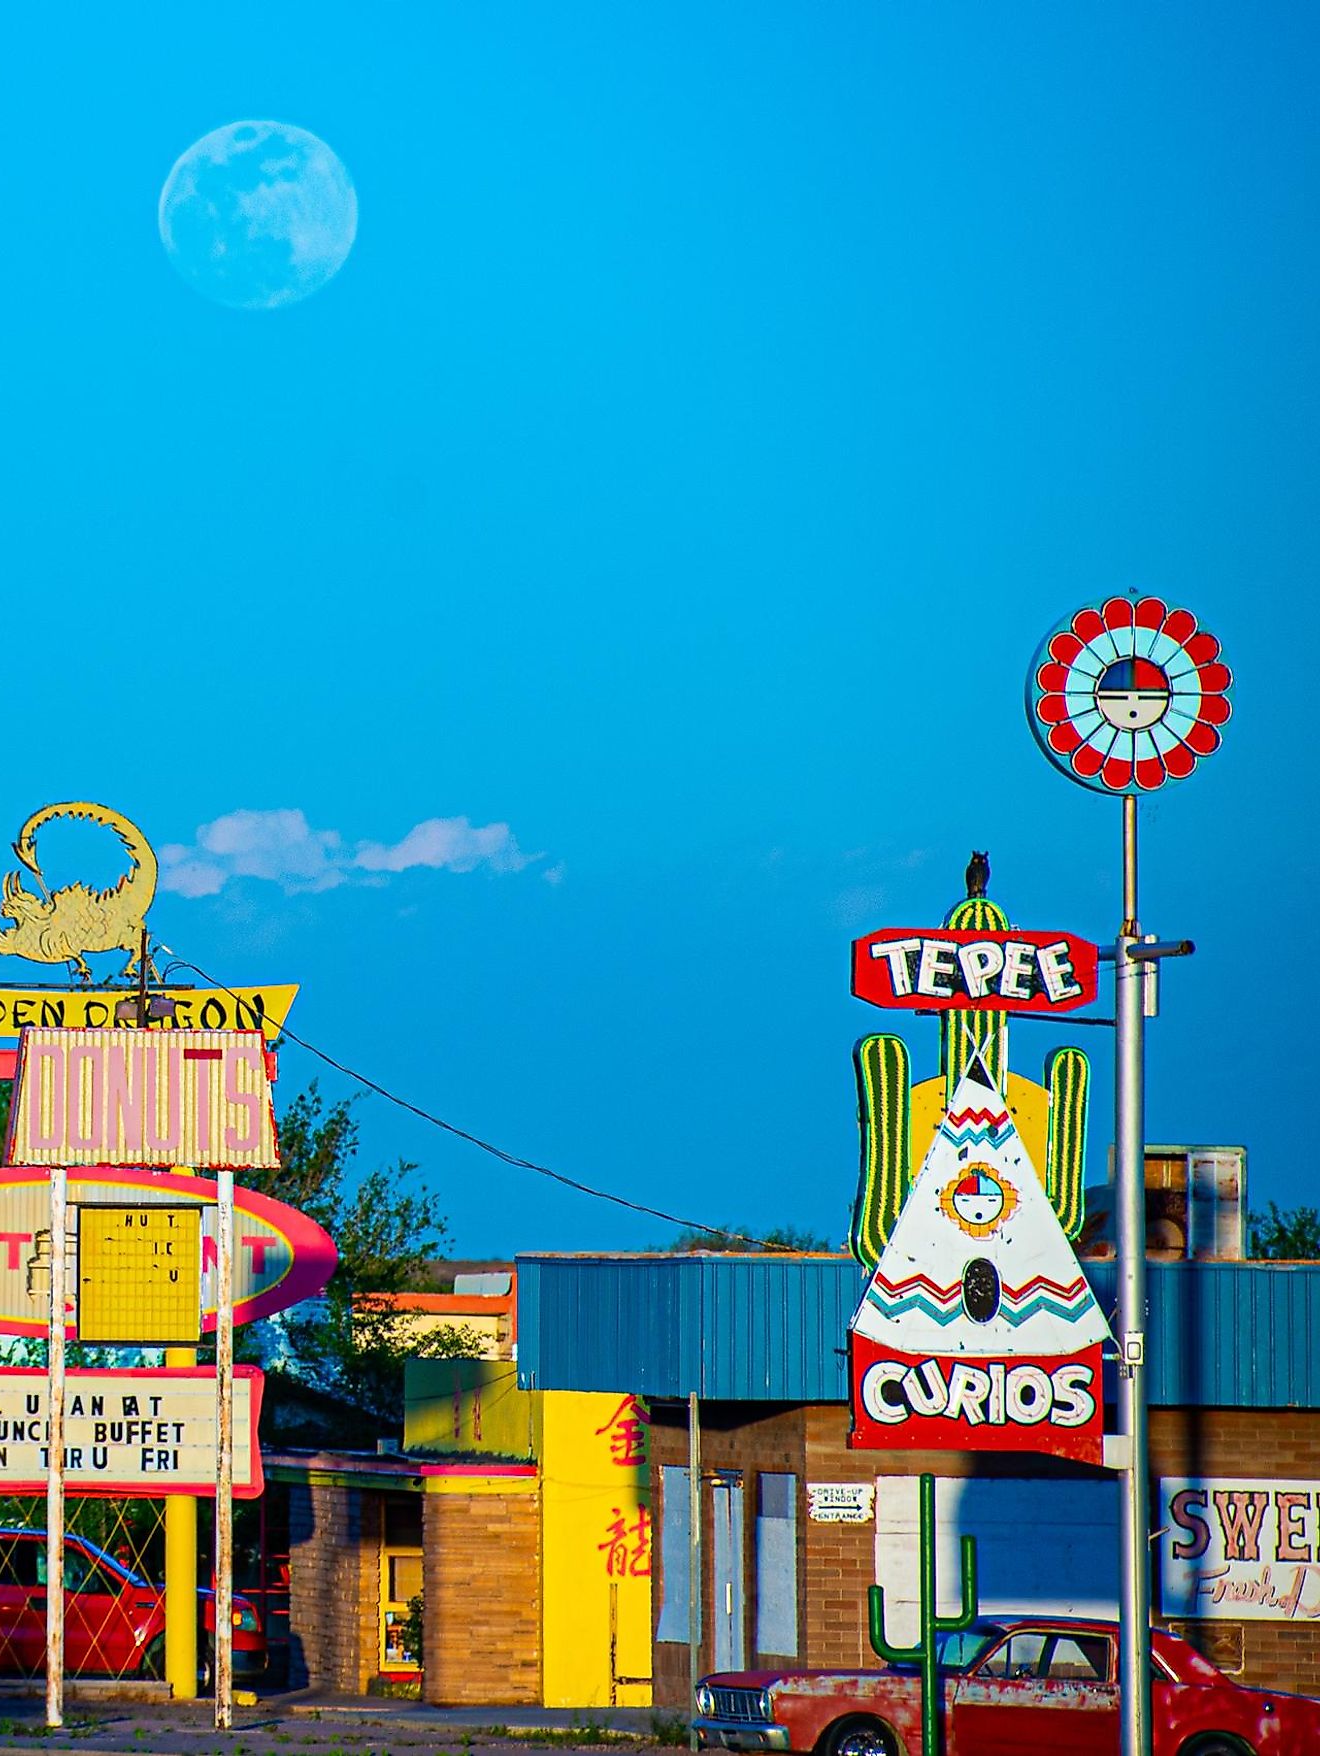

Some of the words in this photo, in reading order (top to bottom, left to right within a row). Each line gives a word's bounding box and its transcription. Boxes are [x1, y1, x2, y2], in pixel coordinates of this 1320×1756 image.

[869, 936, 1084, 1004] TEPEE
[28, 1044, 261, 1153] DONUTS
[26, 1394, 40, 1415] U
[69, 1395, 104, 1416] AN
[860, 1358, 1097, 1427] CURIOS
[94, 1420, 185, 1445] BUFFET
[141, 1448, 179, 1472] FRI
[1168, 1488, 1320, 1563] SWE
